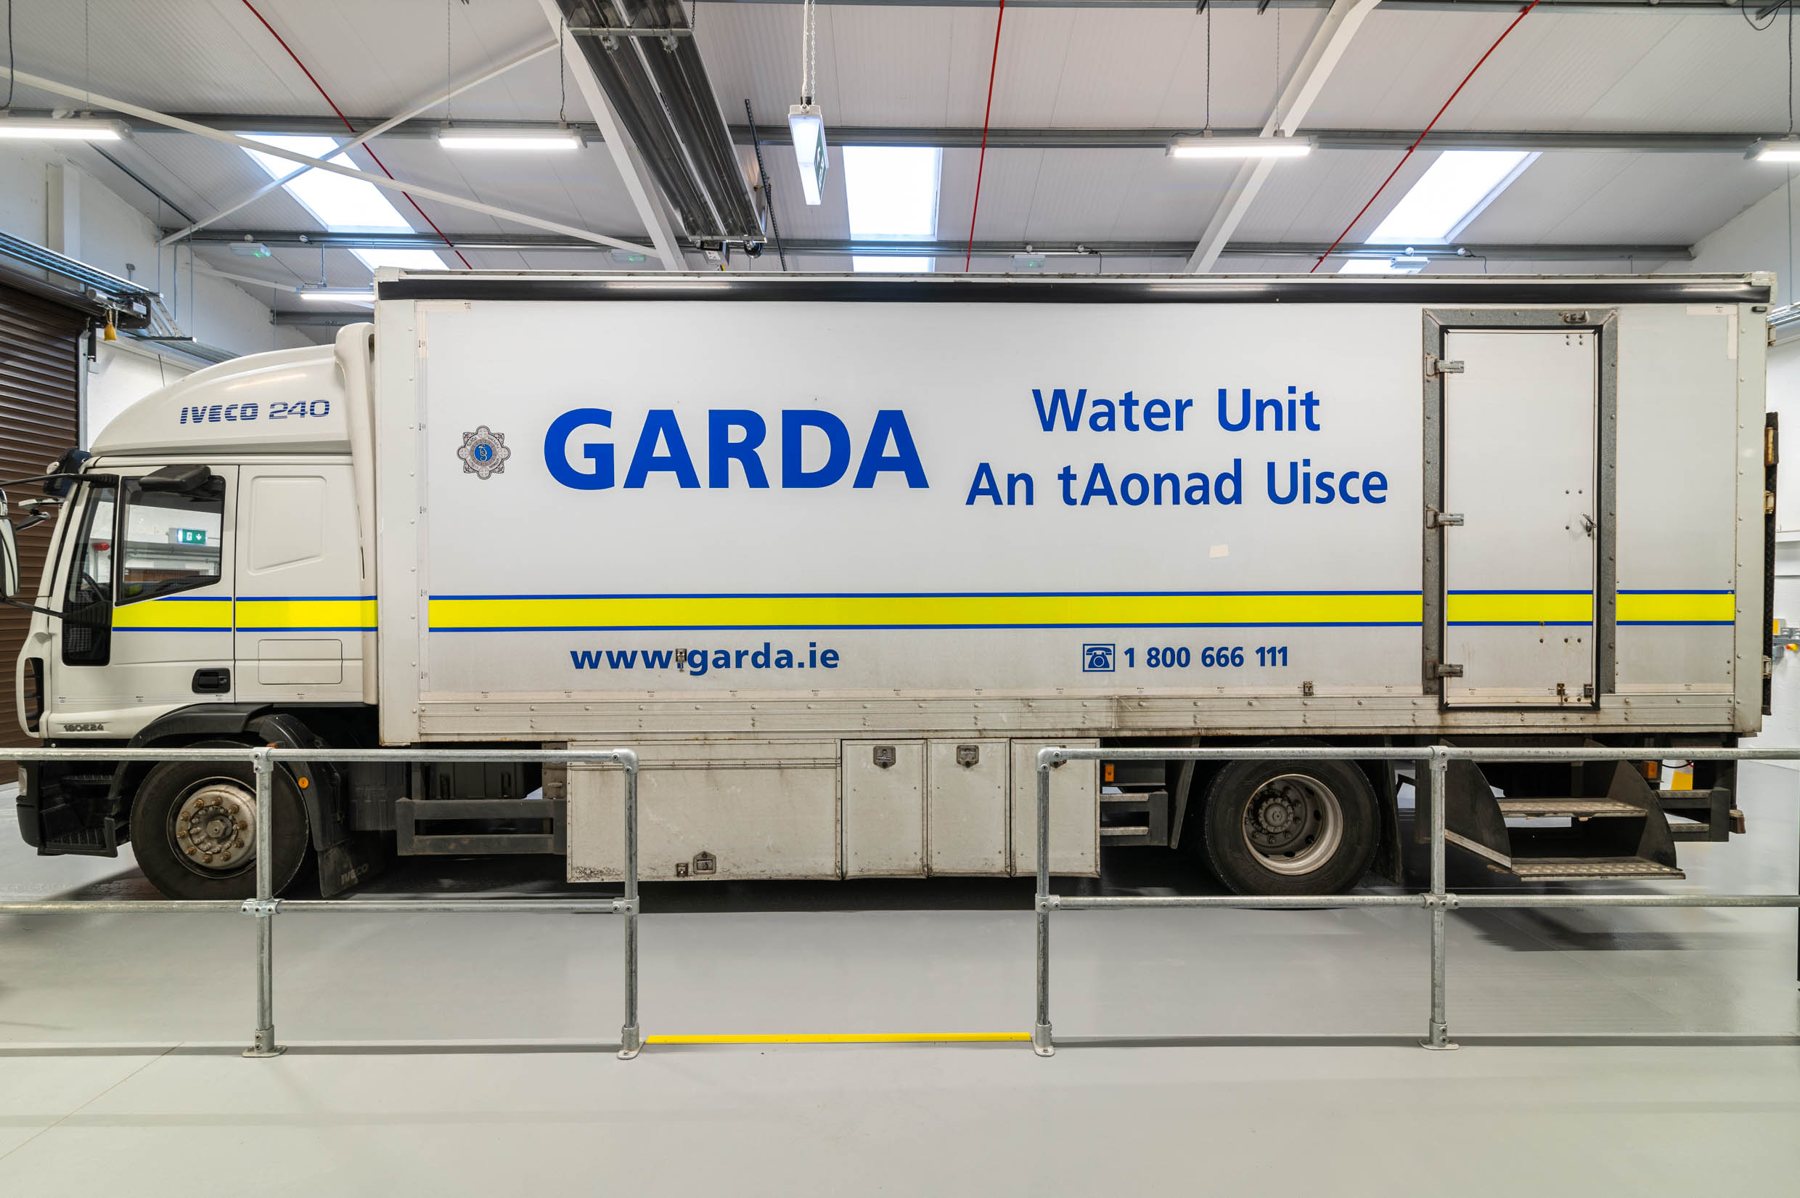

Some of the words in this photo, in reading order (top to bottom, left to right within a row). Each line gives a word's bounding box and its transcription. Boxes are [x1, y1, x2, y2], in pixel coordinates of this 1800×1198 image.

[180, 402, 259, 425] IVECO
[268, 399, 331, 420] 240
[1032, 388, 1193, 432] Water
[1218, 386, 1320, 432] Unit
[544, 408, 929, 490] GARDA
[965, 462, 1034, 506] An
[1057, 457, 1242, 506] tAonad
[1267, 458, 1388, 504] Uisce
[570, 642, 839, 676] www.garda.ie
[1124, 648, 1135, 668] 1
[1146, 646, 1191, 668] 800
[1201, 646, 1245, 668] 666
[1255, 645, 1289, 667] 111
